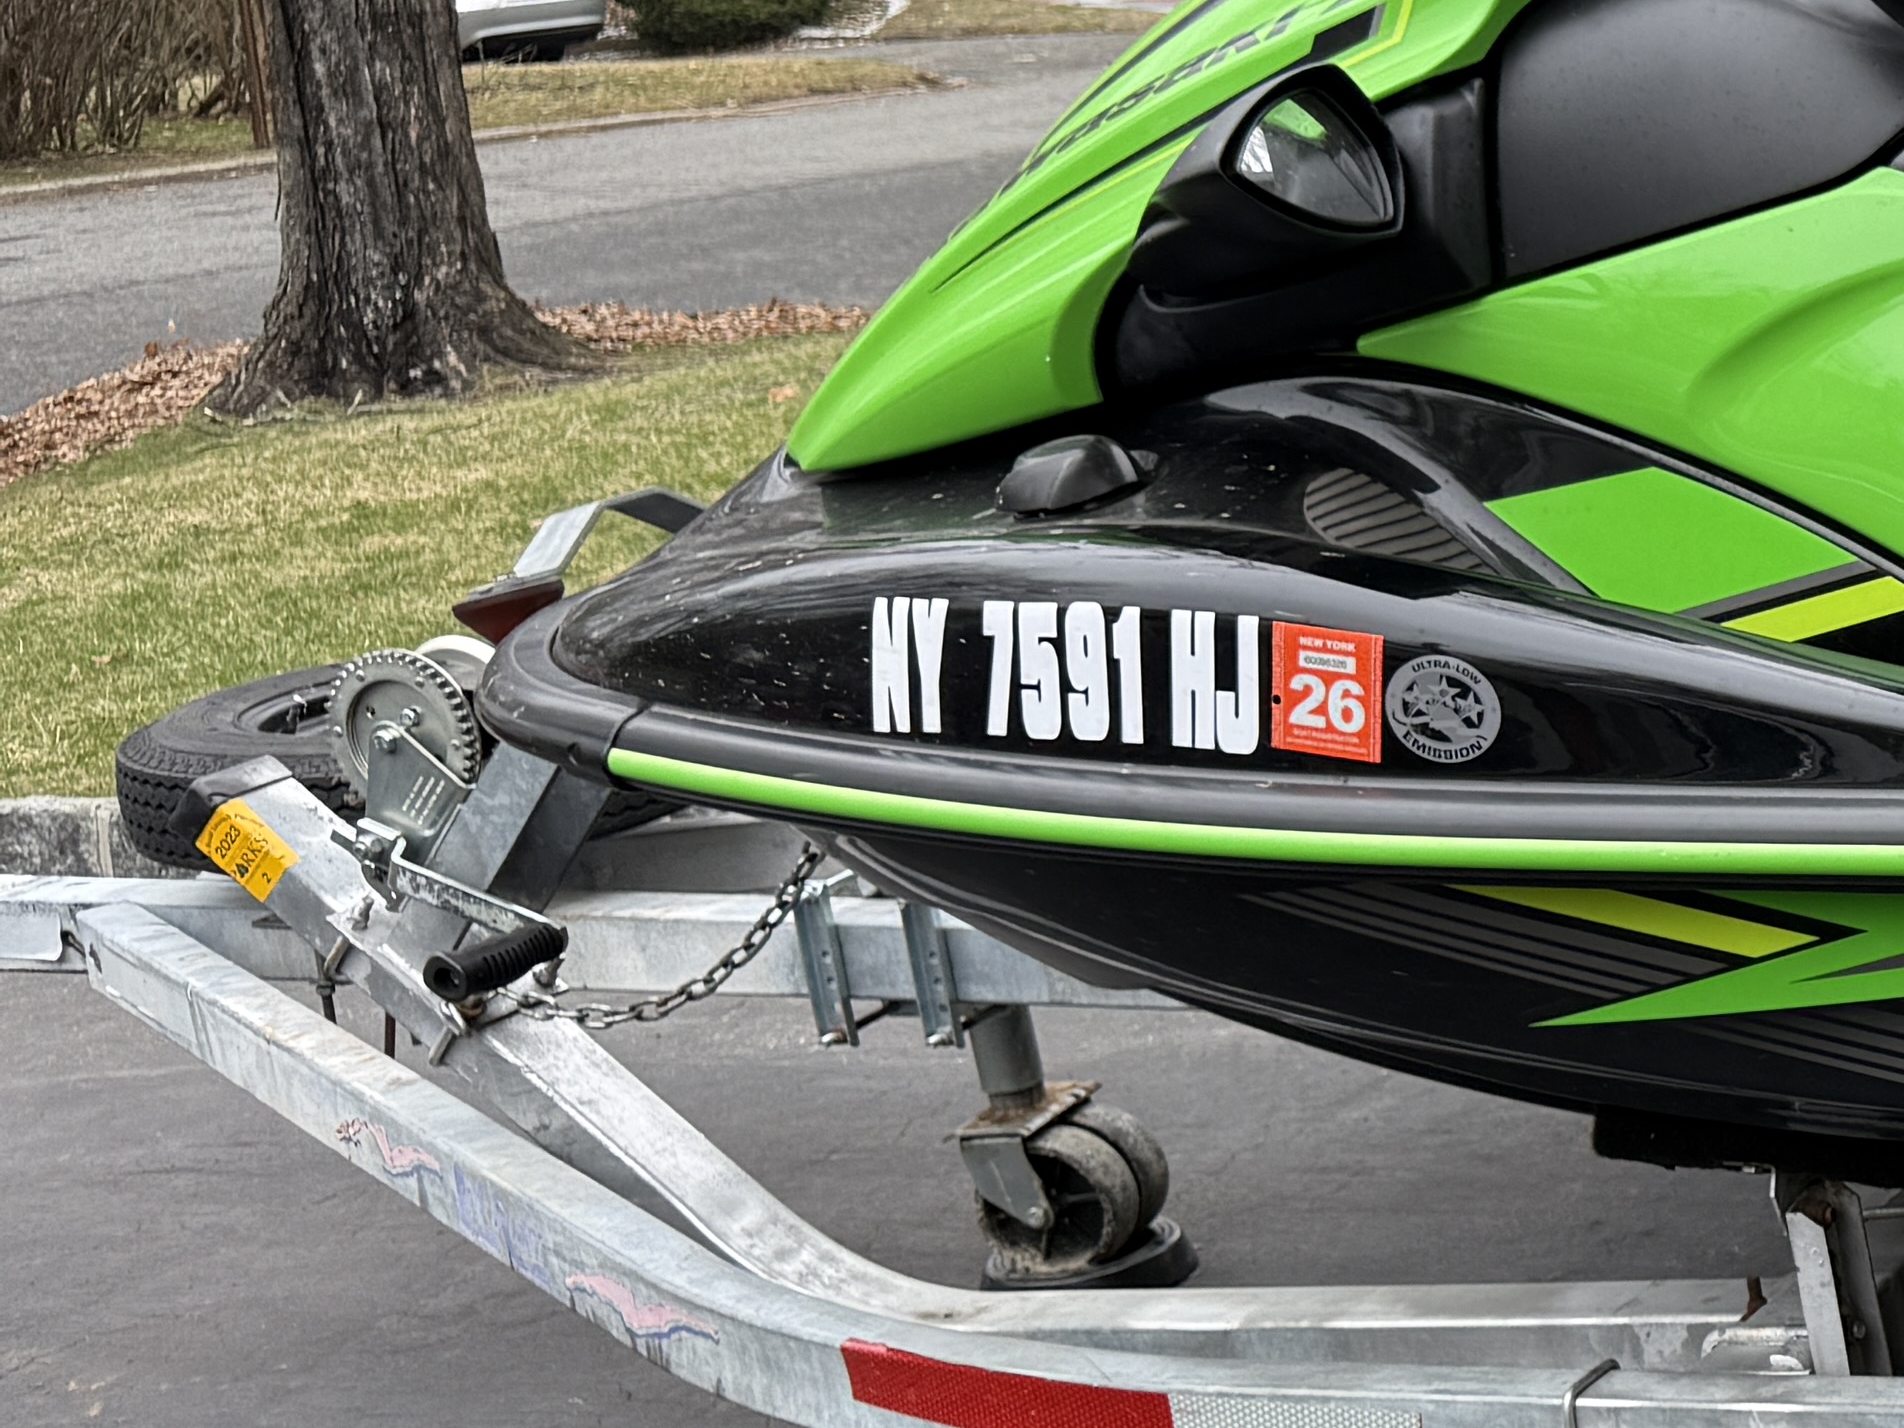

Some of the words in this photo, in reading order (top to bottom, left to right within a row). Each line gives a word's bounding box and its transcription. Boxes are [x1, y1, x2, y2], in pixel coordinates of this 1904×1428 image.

[1299, 636, 1323, 648] NEW
[1326, 639, 1356, 652] YORK
[872, 596, 950, 734] NY
[982, 600, 1145, 745] 7591
[1171, 608, 1260, 755] HJ
[1289, 673, 1365, 734] 26
[215, 824, 241, 860] 2023
